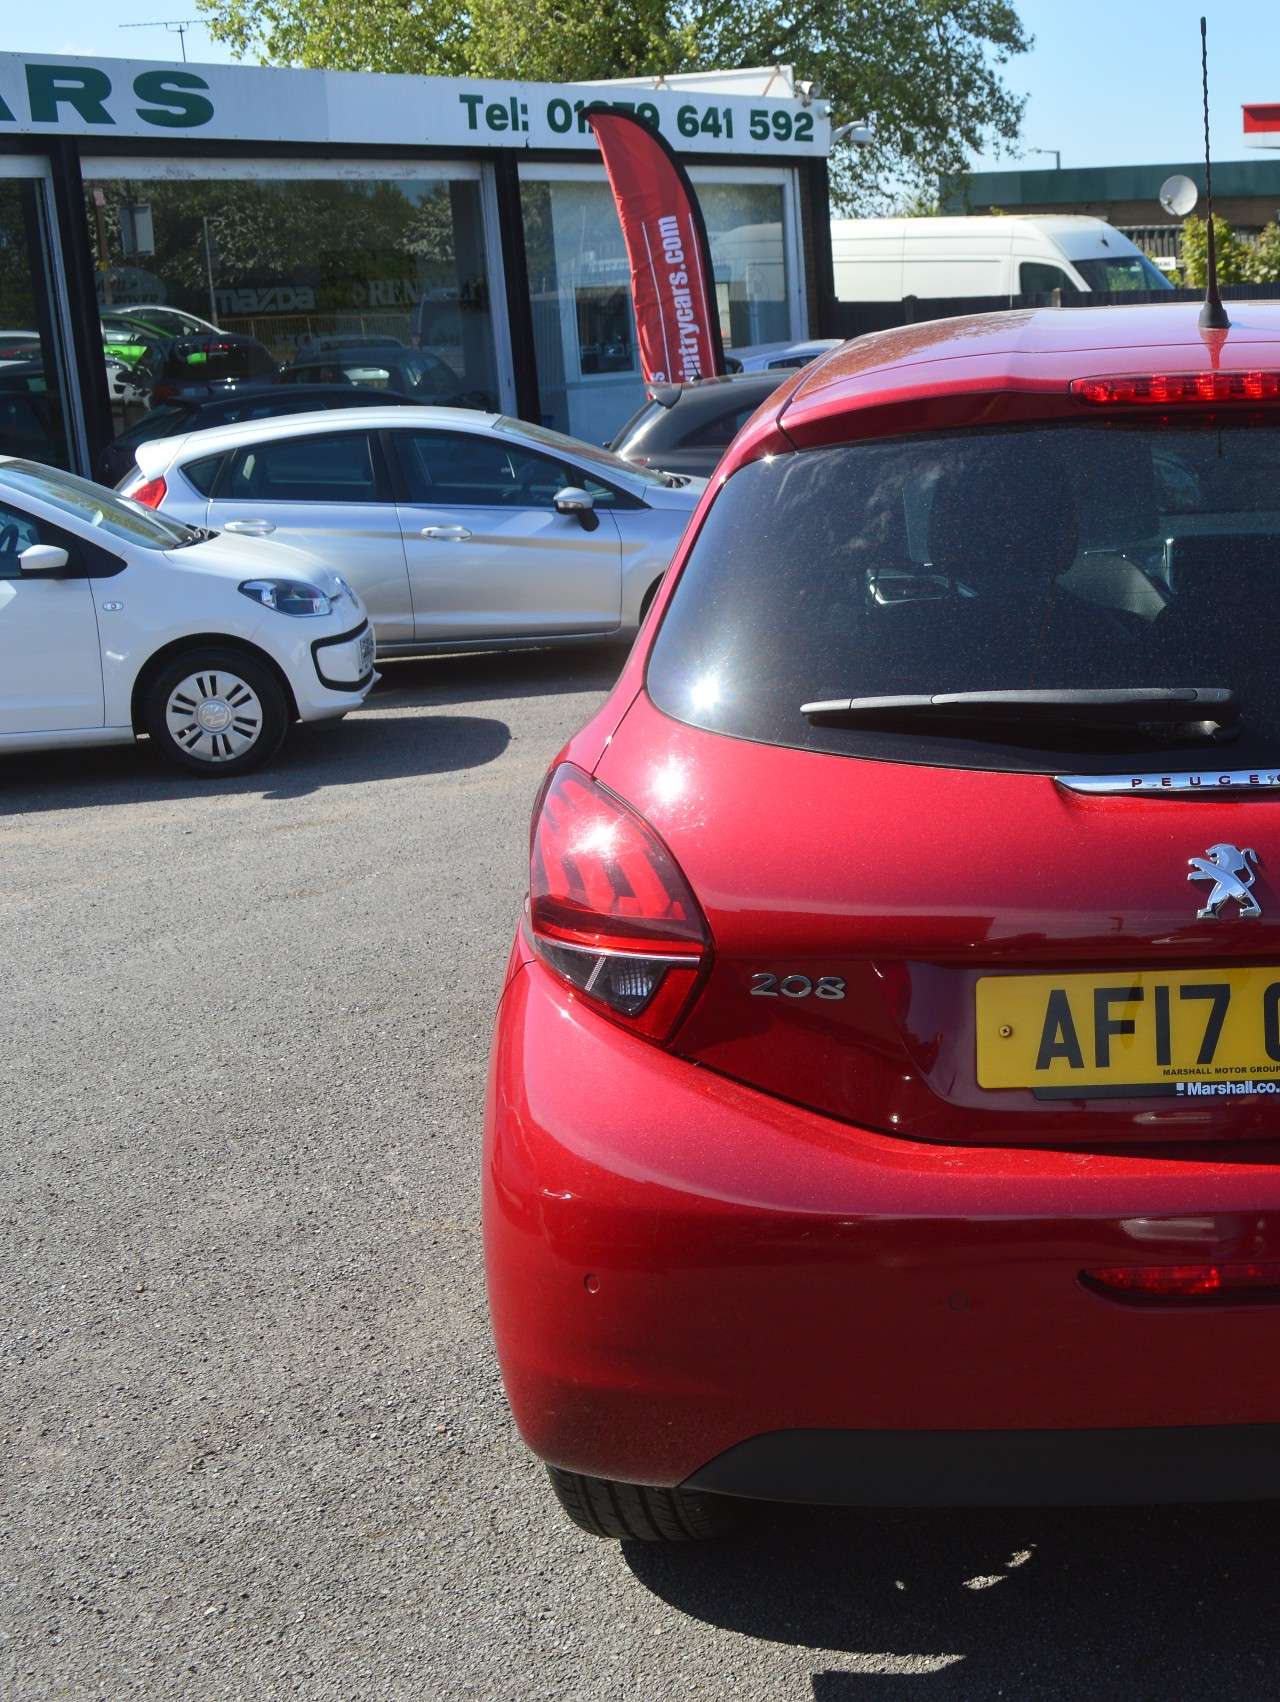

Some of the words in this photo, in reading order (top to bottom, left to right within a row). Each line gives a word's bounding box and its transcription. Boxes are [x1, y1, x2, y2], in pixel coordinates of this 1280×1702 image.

[0, 64, 214, 128] RS
[459, 94, 529, 132] Tel:
[546, 98, 660, 134] 019
[677, 105, 733, 139] 641
[750, 109, 814, 142] 592
[750, 973, 845, 1000] 208
[1035, 983, 1231, 1070] AF17
[1163, 1068, 1212, 1076] MARSHALL
[1214, 1066, 1248, 1074] MOTOR
